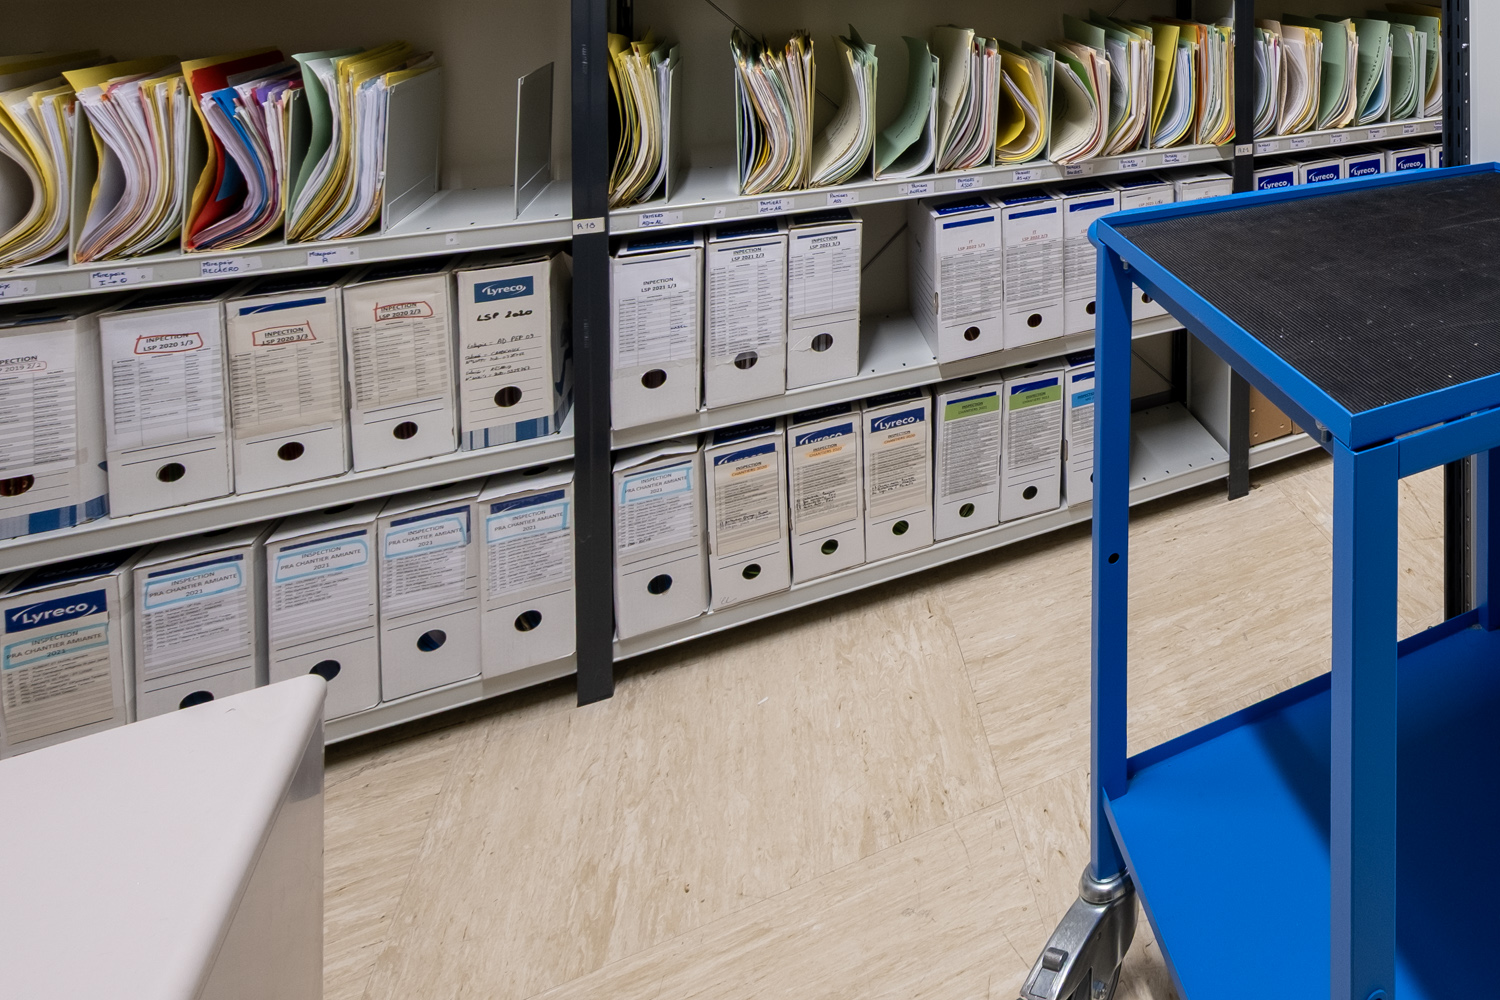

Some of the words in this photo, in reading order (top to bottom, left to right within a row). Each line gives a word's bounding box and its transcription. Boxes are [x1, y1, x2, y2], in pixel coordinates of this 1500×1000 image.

[1353, 165, 1375, 177] Lyreco
[1399, 160, 1421, 171] Lyreco
[1311, 171, 1335, 183] Lyreco
[1263, 180, 1288, 190] Lyreco
[642, 277, 674, 286] INPECTION
[486, 284, 524, 297] Lyreco
[476, 311, 500, 322] LSP
[504, 309, 533, 319] 2020
[264, 327, 304, 338] INPECTION
[159, 341, 179, 349] 2020
[276, 335, 295, 343] 2020
[879, 415, 915, 430] Lyreco
[640, 473, 672, 484] INSPECTION
[636, 480, 663, 491] CHANTIER
[507, 519, 536, 529] CHANTIER
[536, 511, 564, 522] AMIANTE
[512, 510, 546, 521] INSPECTION
[407, 524, 445, 536] INSPECTION
[522, 524, 536, 532] 2021
[388, 539, 401, 547] PRA
[402, 534, 433, 544] CHANTIER
[434, 527, 463, 538] AMIANTE
[418, 540, 433, 548] 2021
[301, 545, 342, 559] INSPECTION
[280, 563, 294, 571] PRA
[296, 555, 329, 568] CHANTIER
[330, 548, 361, 560] AMIANTE
[313, 562, 330, 570] 2021
[171, 571, 215, 586] INSPECTION
[149, 590, 165, 598] PRA
[166, 581, 203, 595] CHANTIER
[204, 572, 237, 585] AMIANTE
[185, 588, 203, 597] 2021
[22, 601, 89, 625] Lyreco
[31, 629, 79, 646] INSPECTION
[6, 651, 23, 660] PRA
[24, 642, 65, 656] CHANTIER
[66, 632, 103, 645] AMIANTE
